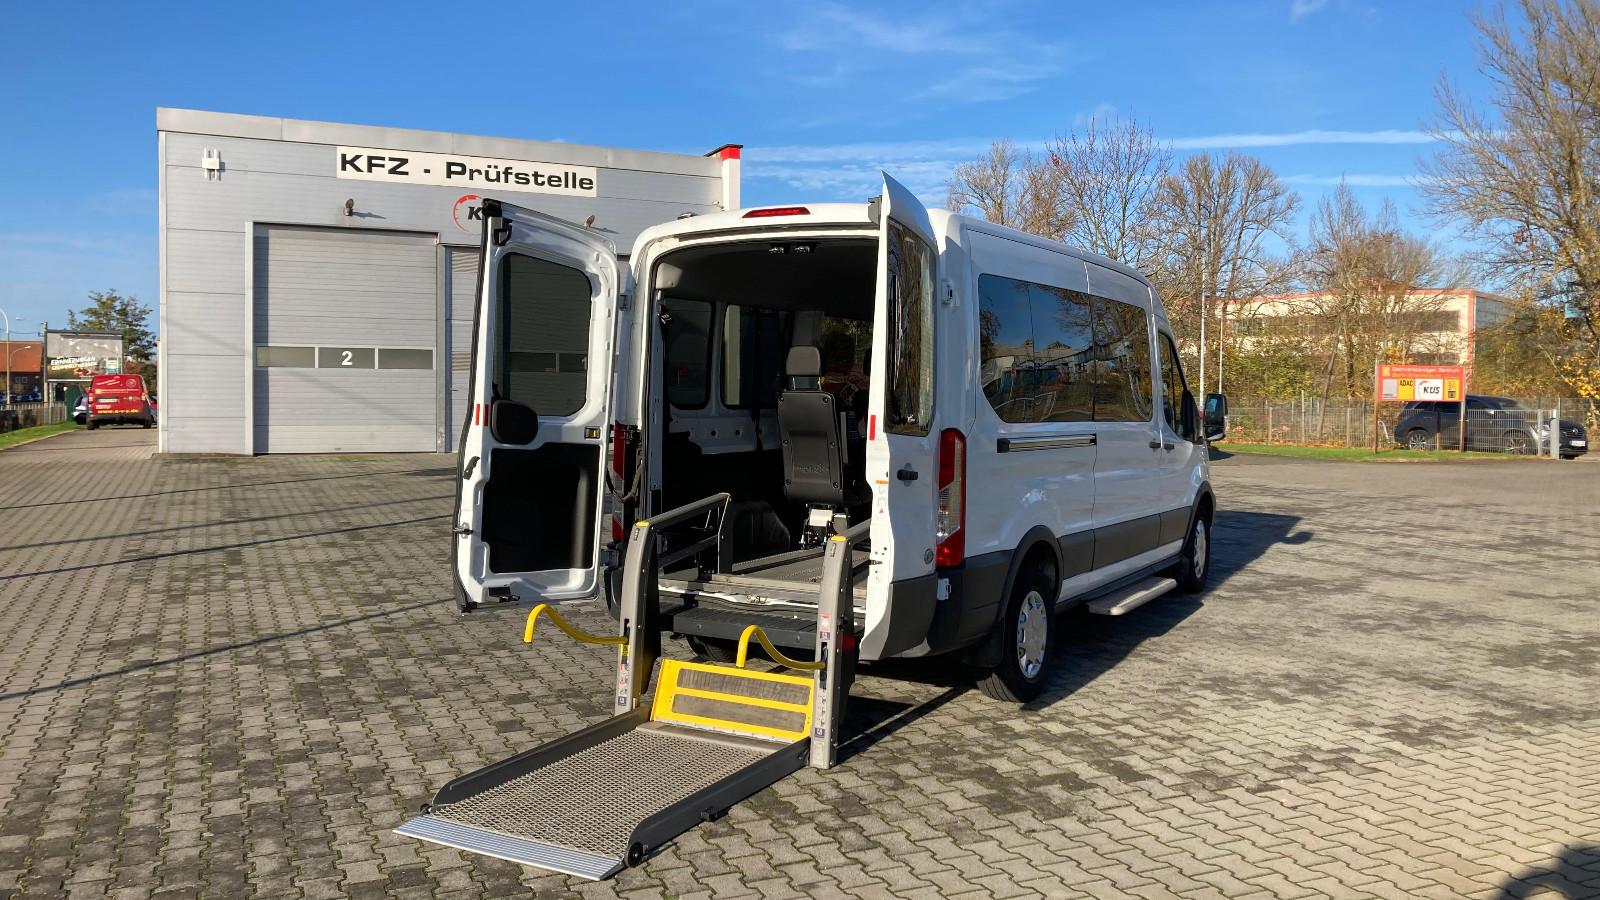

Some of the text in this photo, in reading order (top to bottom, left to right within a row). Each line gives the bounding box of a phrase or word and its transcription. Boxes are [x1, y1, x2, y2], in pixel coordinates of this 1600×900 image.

[340, 153, 410, 176] KFZ
[445, 161, 594, 190] Prüfstelle
[341, 350, 353, 366] 2
